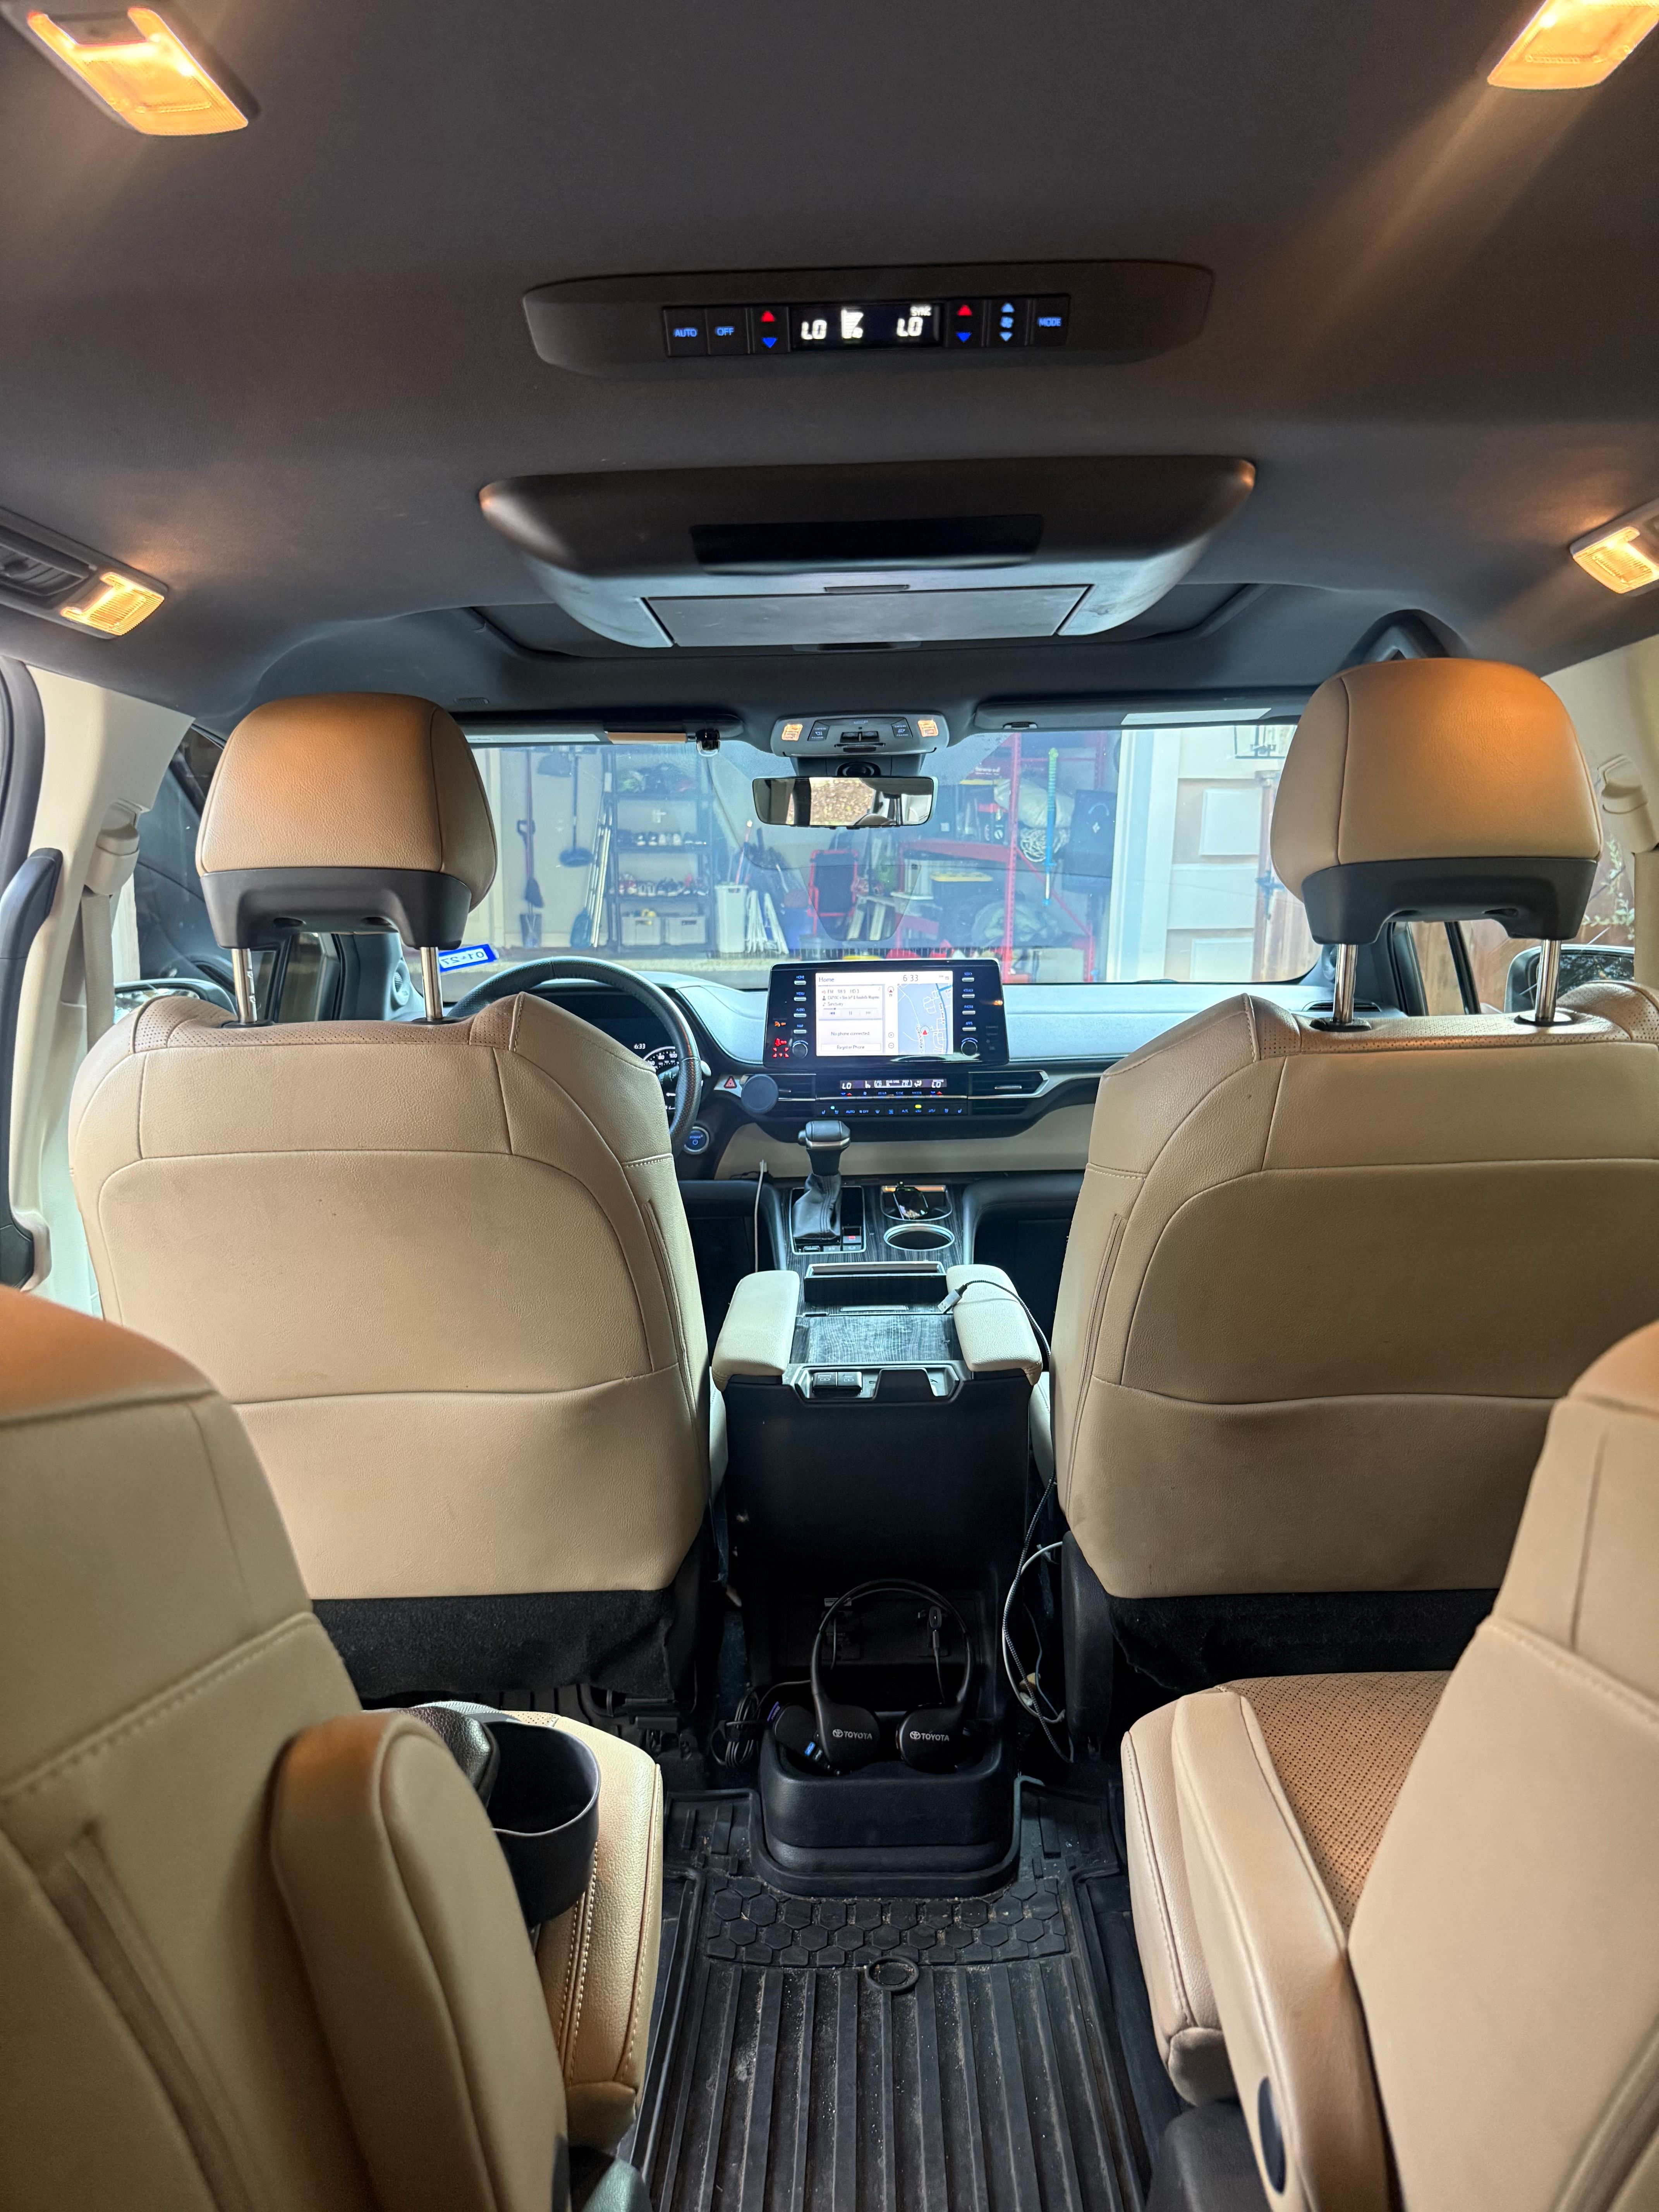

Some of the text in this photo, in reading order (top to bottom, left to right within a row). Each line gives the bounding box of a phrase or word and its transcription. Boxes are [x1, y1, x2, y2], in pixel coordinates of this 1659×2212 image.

[910, 306, 931, 316] SYNC
[896, 317, 923, 337] LO
[1038, 317, 1061, 327] MODE
[675, 328, 697, 337] AUTO
[716, 326, 734, 336] OFF
[801, 319, 827, 340] LO
[844, 1731, 872, 1740] TOYOTA
[921, 1733, 950, 1741] TOYOTA
